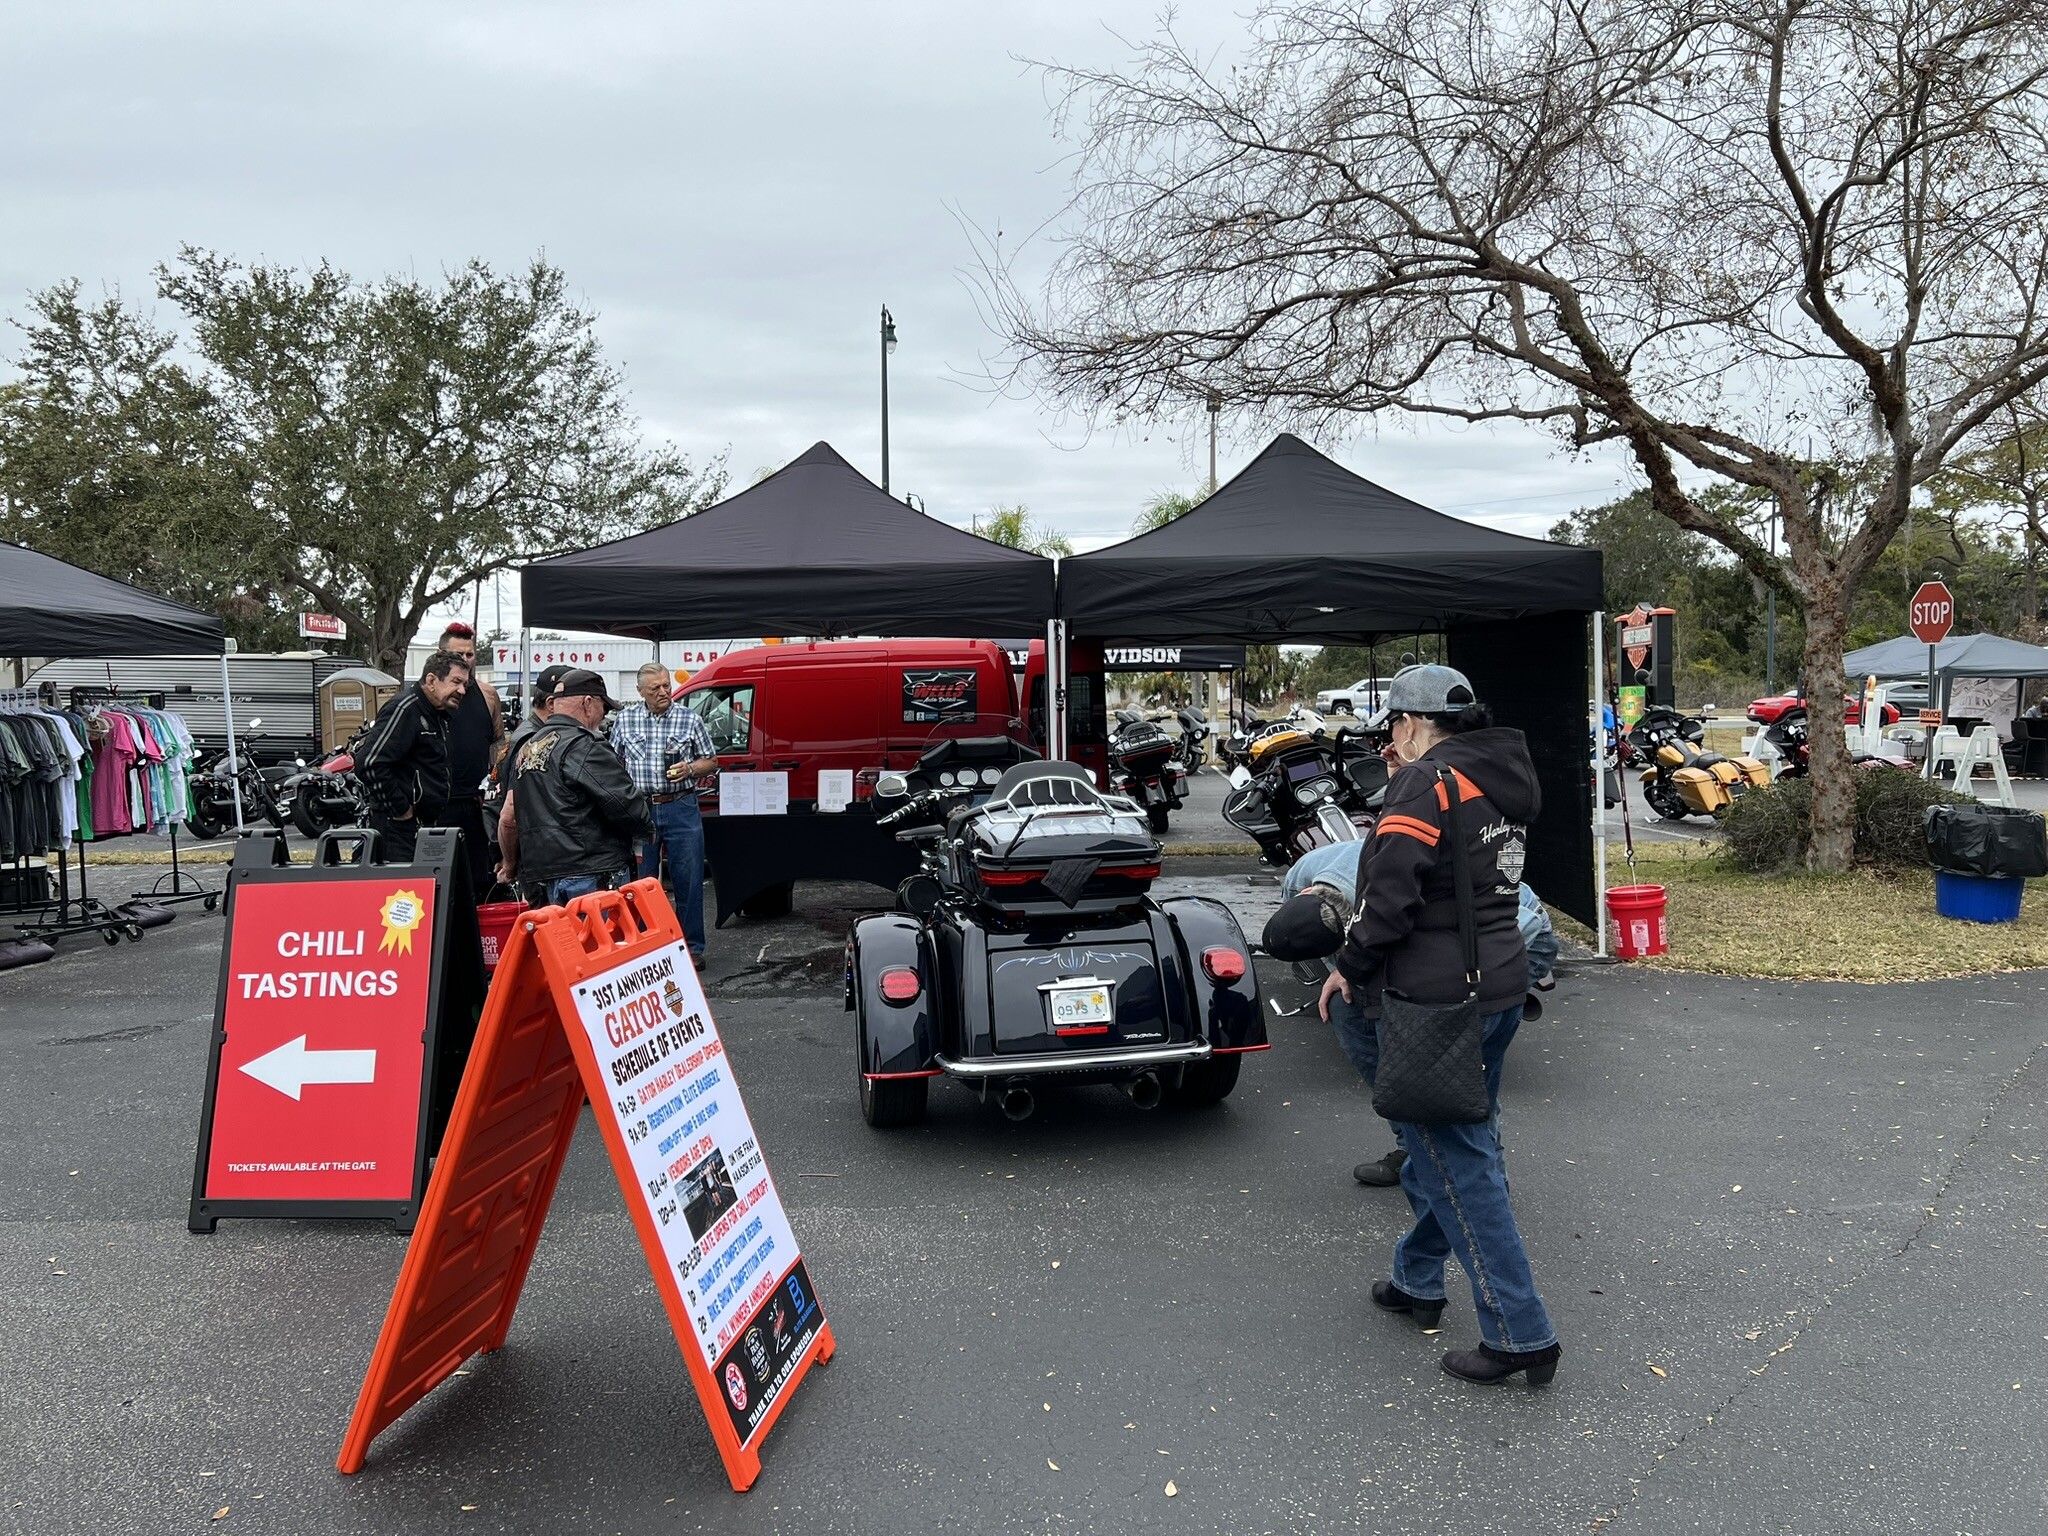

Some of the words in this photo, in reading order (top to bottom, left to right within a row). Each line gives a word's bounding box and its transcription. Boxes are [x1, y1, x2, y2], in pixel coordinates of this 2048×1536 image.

[1913, 601, 1950, 625] STOP
[498, 649, 605, 662] Fiestone
[1104, 648, 1181, 664] VIDSON
[914, 684, 965, 698] WELLS
[277, 930, 364, 957] CHILI
[237, 970, 398, 999] TASTINGS
[592, 983, 615, 1009] 31ST
[616, 956, 674, 999] ANNIVERSARY
[604, 991, 666, 1047] GATOR
[611, 1039, 659, 1085] SCHEDULE
[656, 1031, 669, 1057] OF
[668, 1013, 704, 1050] EVENTS
[637, 1081, 657, 1104] GATOR
[654, 1068, 676, 1092] HARLEY
[673, 1050, 703, 1079] DEALERSHIP
[646, 1094, 684, 1130] REGISTRATION
[681, 1083, 698, 1104] ELITE
[228, 1163, 266, 1172] TICKETS
[267, 1162, 317, 1171] AVAILABLE
[318, 1162, 331, 1171] AT
[332, 1162, 350, 1171] THE
[351, 1161, 376, 1170] GATE
[667, 1152, 691, 1180] VENDORS
[689, 1143, 701, 1161] ARE
[698, 1134, 713, 1154] OPEN
[728, 1154, 735, 1166] ON
[733, 1145, 744, 1160] THE
[742, 1136, 754, 1154] FRAN
[747, 1150, 761, 1169] STAGE
[699, 1231, 715, 1255] GATE
[713, 1217, 729, 1241] OPENS
[726, 1208, 738, 1226] FOR
[735, 1196, 749, 1217] CHILI
[729, 1300, 750, 1333] WINNERS
[748, 1398, 766, 1427] THANK
[763, 1383, 776, 1402] YOU
[773, 1373, 782, 1387] TO
[780, 1359, 792, 1377] OUR
[790, 1328, 812, 1363] SPONSORS
